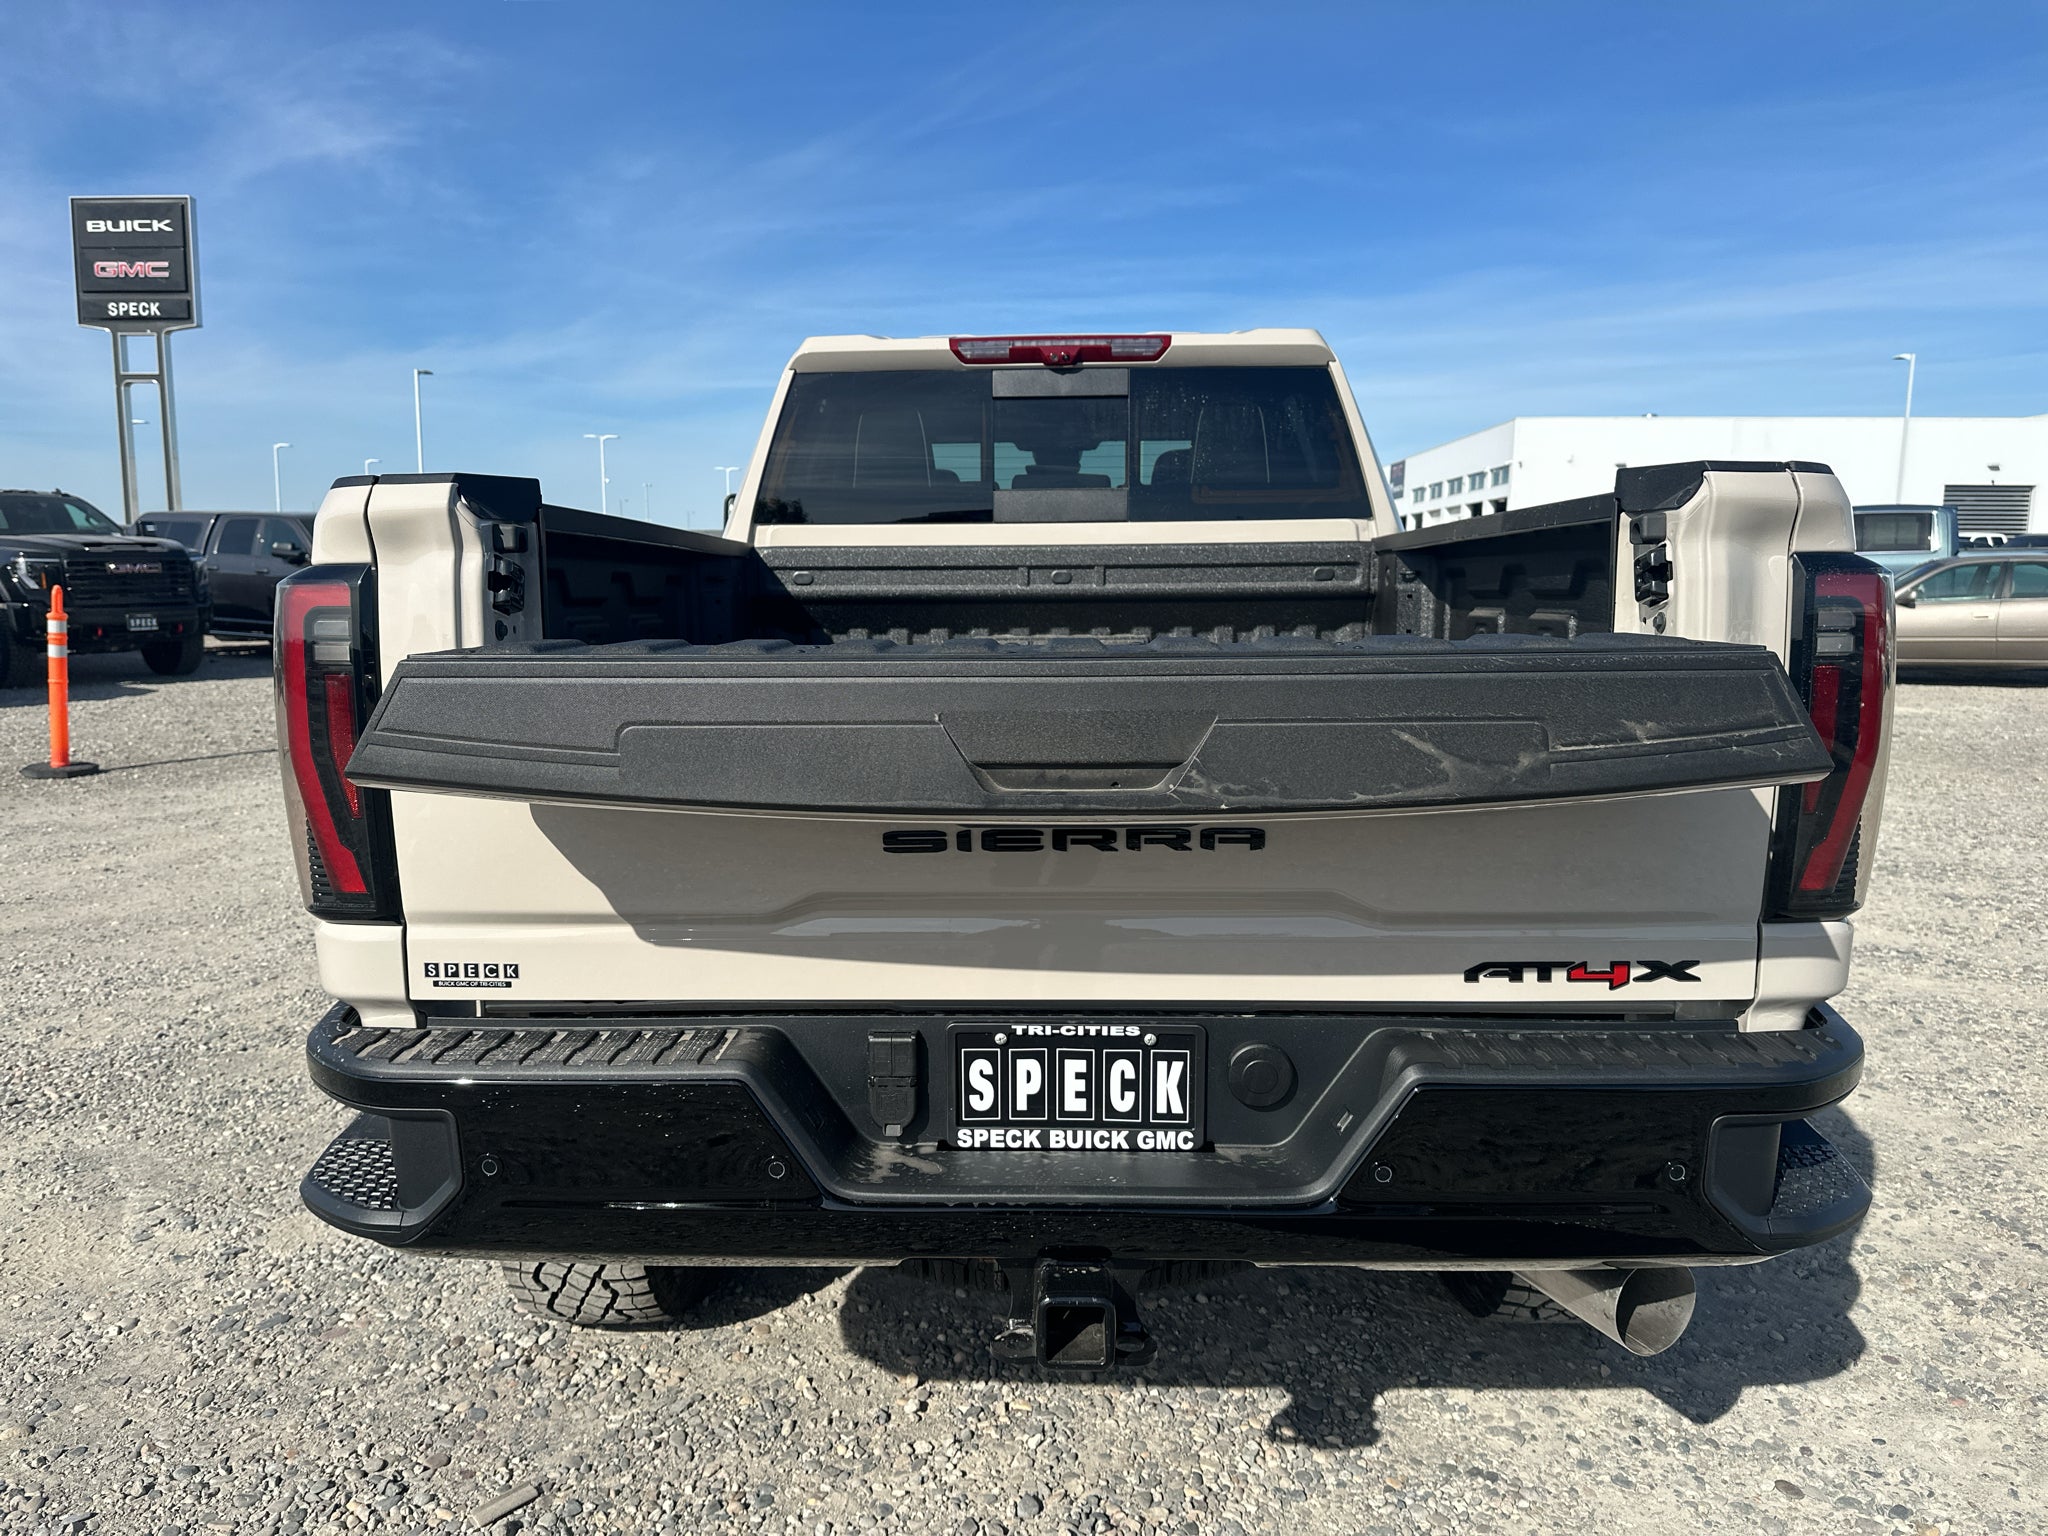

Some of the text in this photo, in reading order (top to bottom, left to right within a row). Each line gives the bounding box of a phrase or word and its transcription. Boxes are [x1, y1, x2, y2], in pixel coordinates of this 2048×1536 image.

[86, 219, 174, 232] BUICK
[93, 261, 170, 278] GMC
[107, 302, 161, 317] SPECK
[882, 827, 1266, 854] SIERRA
[427, 964, 516, 977] SPECK
[1463, 961, 1702, 991] AT4X
[1011, 1025, 1141, 1037] TRI-CITIES
[968, 1058, 1185, 1114] SPECK
[957, 1129, 1195, 1150] SPECK BUICK GMC
